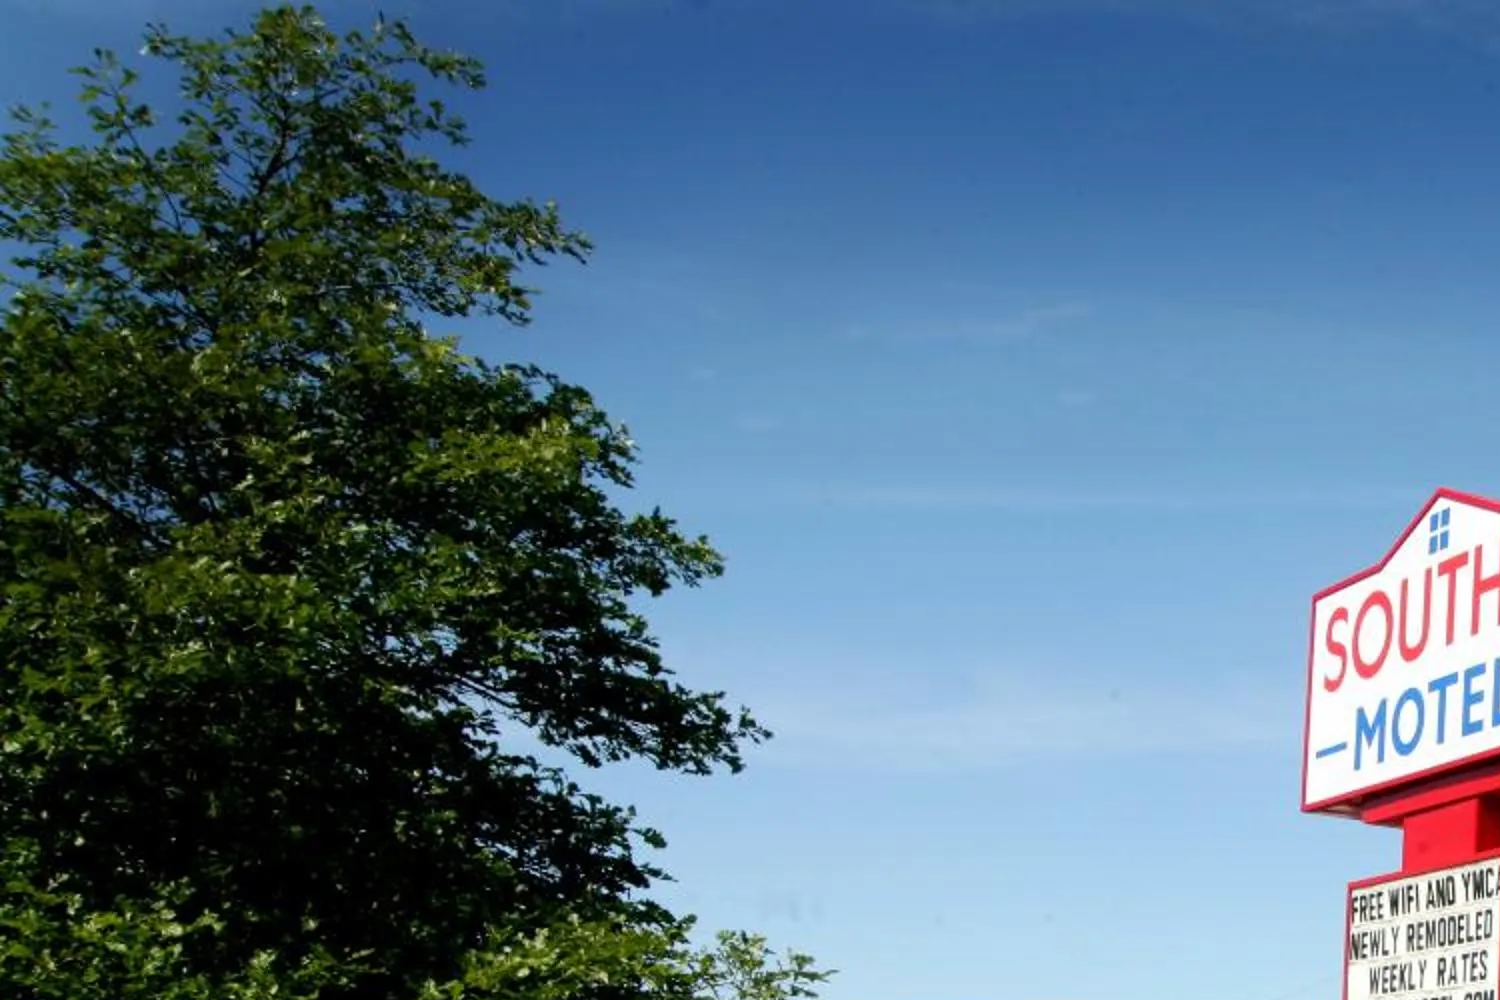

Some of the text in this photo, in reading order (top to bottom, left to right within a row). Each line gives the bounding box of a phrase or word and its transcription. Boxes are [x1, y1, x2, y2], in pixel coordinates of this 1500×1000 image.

[1351, 892, 1384, 924] FREE
[1388, 883, 1421, 916] WIFI
[1426, 876, 1456, 911] AND
[1350, 909, 1493, 959] NEWLY REMODELED
[1369, 950, 1488, 994] WEEKLY RATES
